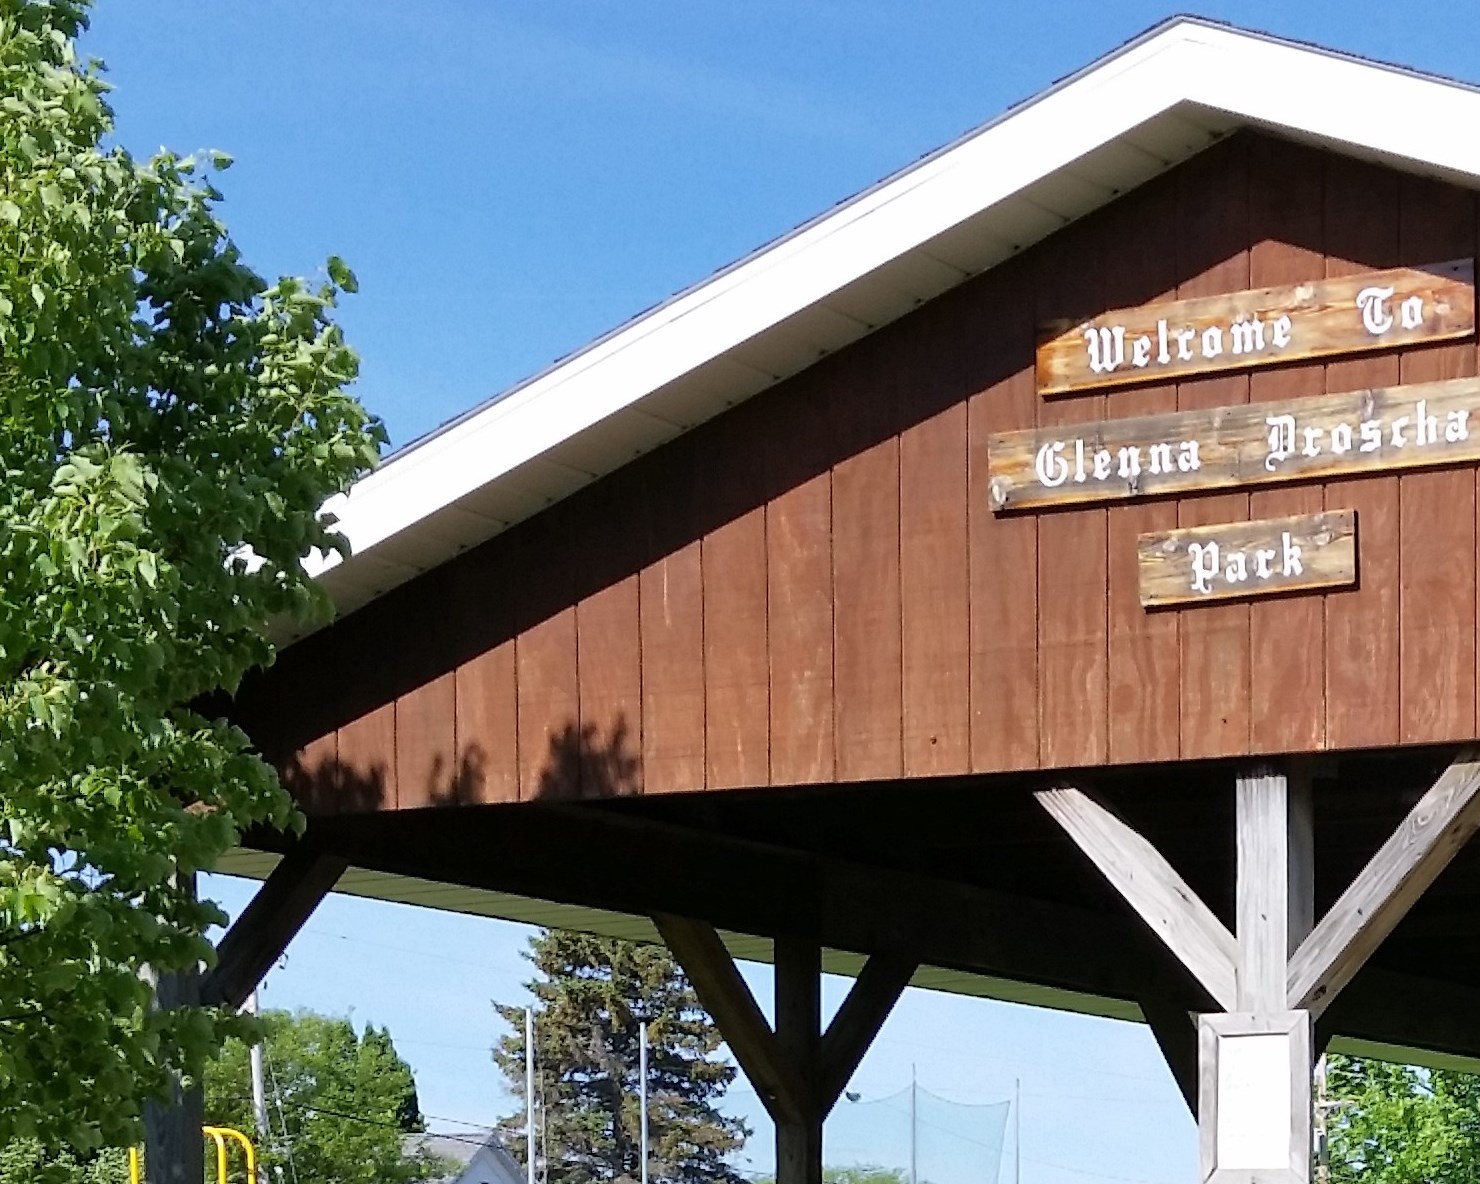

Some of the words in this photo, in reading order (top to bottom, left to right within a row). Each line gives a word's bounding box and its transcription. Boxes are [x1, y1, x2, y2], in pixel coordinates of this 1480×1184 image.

[1084, 313, 1293, 374] Welcome
[1355, 285, 1426, 336] To
[1034, 438, 1201, 488] Glenna
[1263, 398, 1470, 473] Droscha
[1187, 530, 1305, 594] Park
